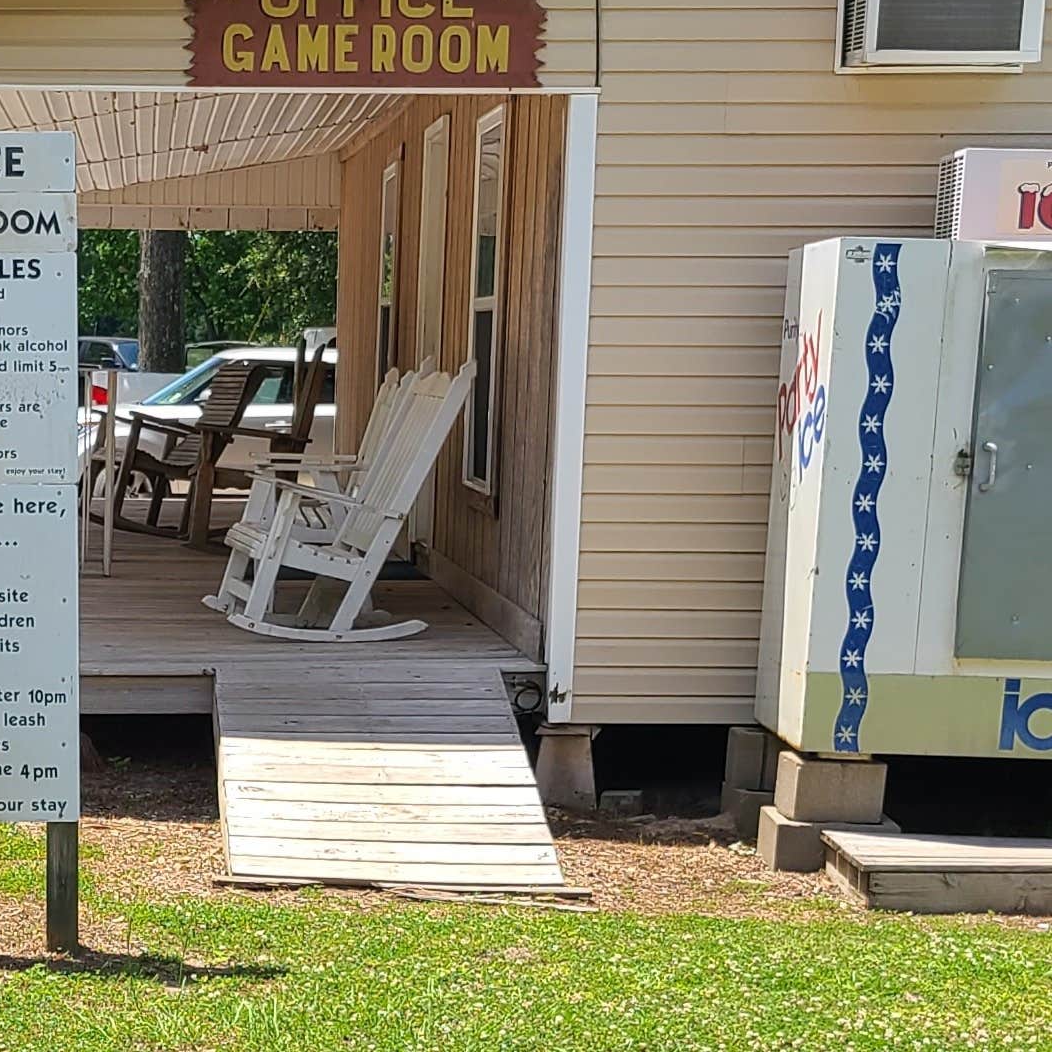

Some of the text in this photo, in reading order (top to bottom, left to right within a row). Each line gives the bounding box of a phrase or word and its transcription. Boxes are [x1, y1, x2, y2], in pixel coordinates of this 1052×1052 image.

[223, 23, 510, 74] GAME ROOM
[18, 340, 67, 351] alcohol
[14, 360, 44, 372] limit
[49, 361, 56, 372] 5
[19, 403, 40, 412] are
[14, 498, 65, 517] here,
[0, 589, 28, 602] site
[29, 690, 66, 706] 10pm
[5, 713, 45, 726] leash
[32, 799, 66, 816] stay
